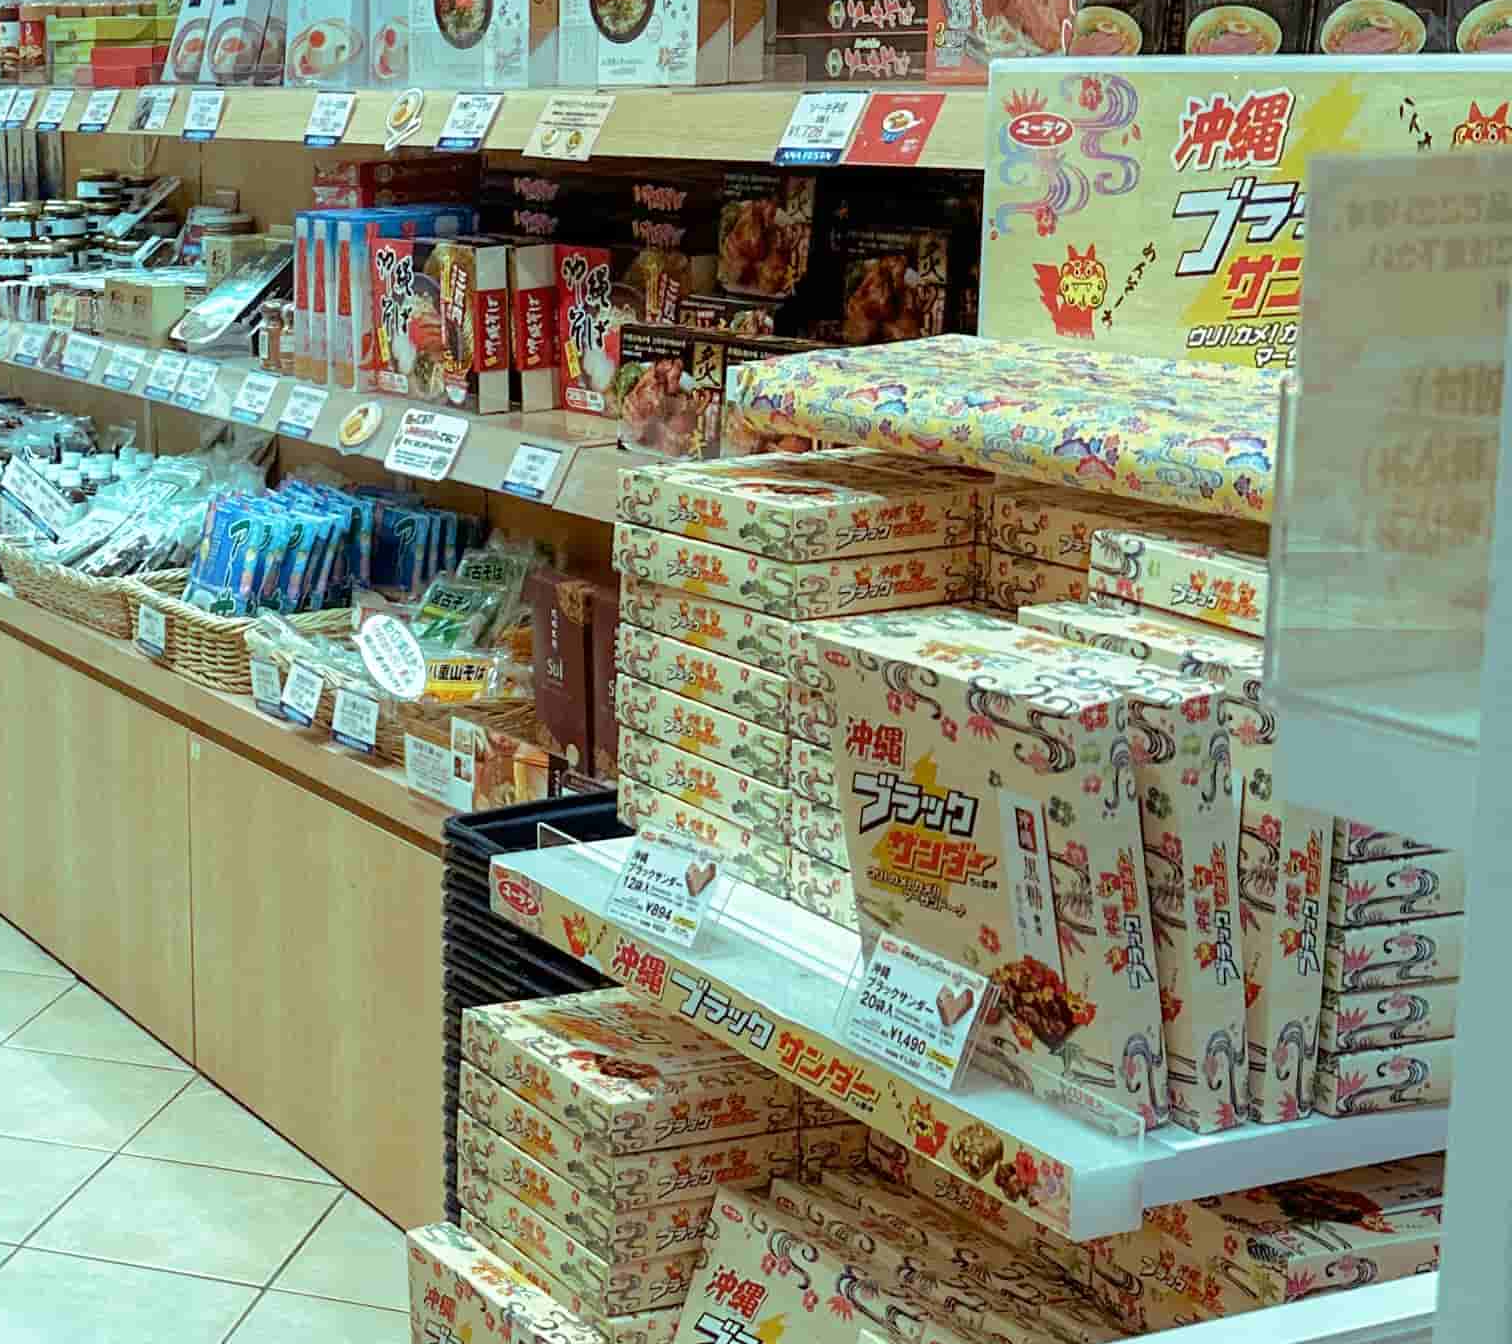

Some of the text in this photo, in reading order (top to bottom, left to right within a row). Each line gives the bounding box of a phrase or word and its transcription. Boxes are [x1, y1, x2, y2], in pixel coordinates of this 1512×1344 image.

[1016, 121, 1066, 137] ユーラク
[1174, 90, 1294, 171] 沖縄
[845, 713, 907, 770] 沖縄
[851, 770, 980, 839] ブラック
[611, 936, 670, 1002] 沖縄
[671, 967, 777, 1051] ブラック
[889, 1024, 927, 1056] ¥1,490
[655, 1114, 712, 1145] ブラック
[657, 1169, 715, 1200] ブラック
[703, 1263, 769, 1324] 沖縄
